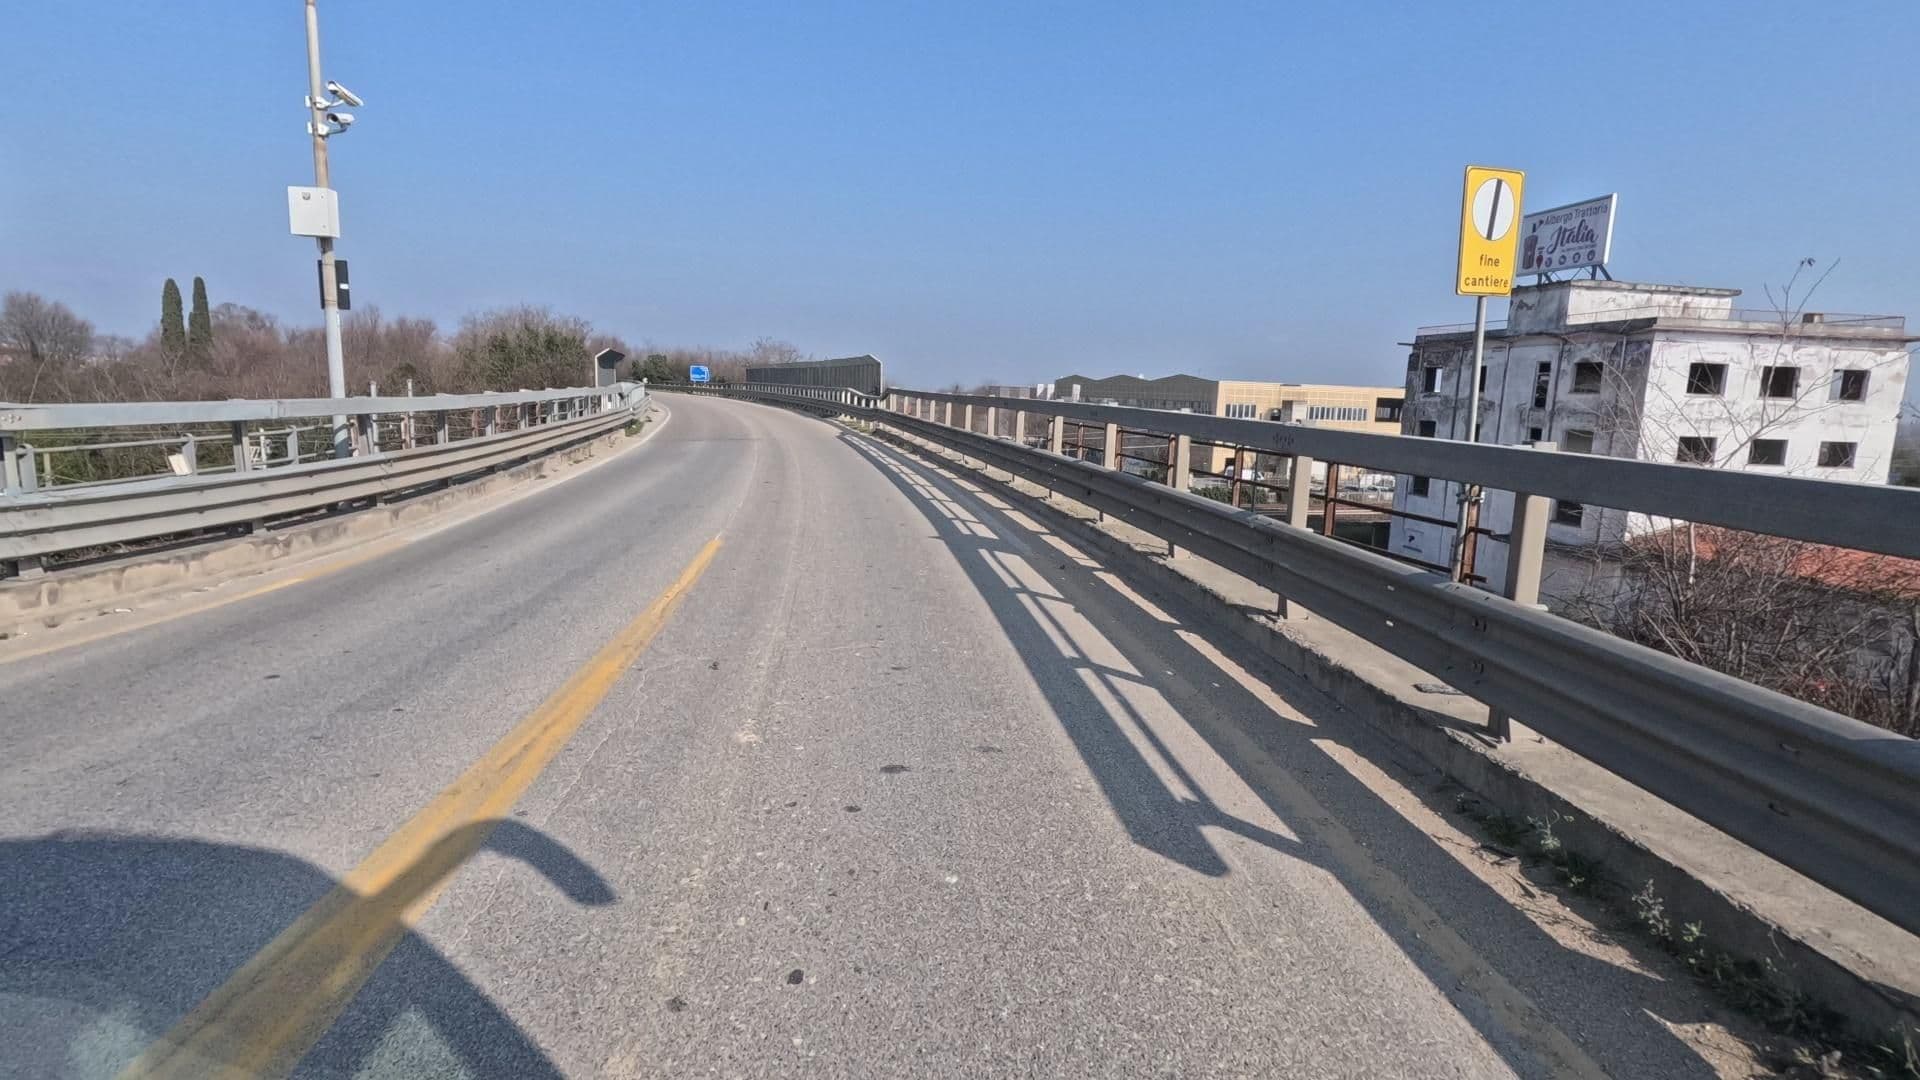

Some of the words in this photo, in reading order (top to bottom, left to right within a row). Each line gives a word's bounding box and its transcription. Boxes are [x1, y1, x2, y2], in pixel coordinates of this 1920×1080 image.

[1546, 219, 1598, 254] Italia
[1479, 254, 1500, 266] fine
[1464, 275, 1509, 288] cantiere
